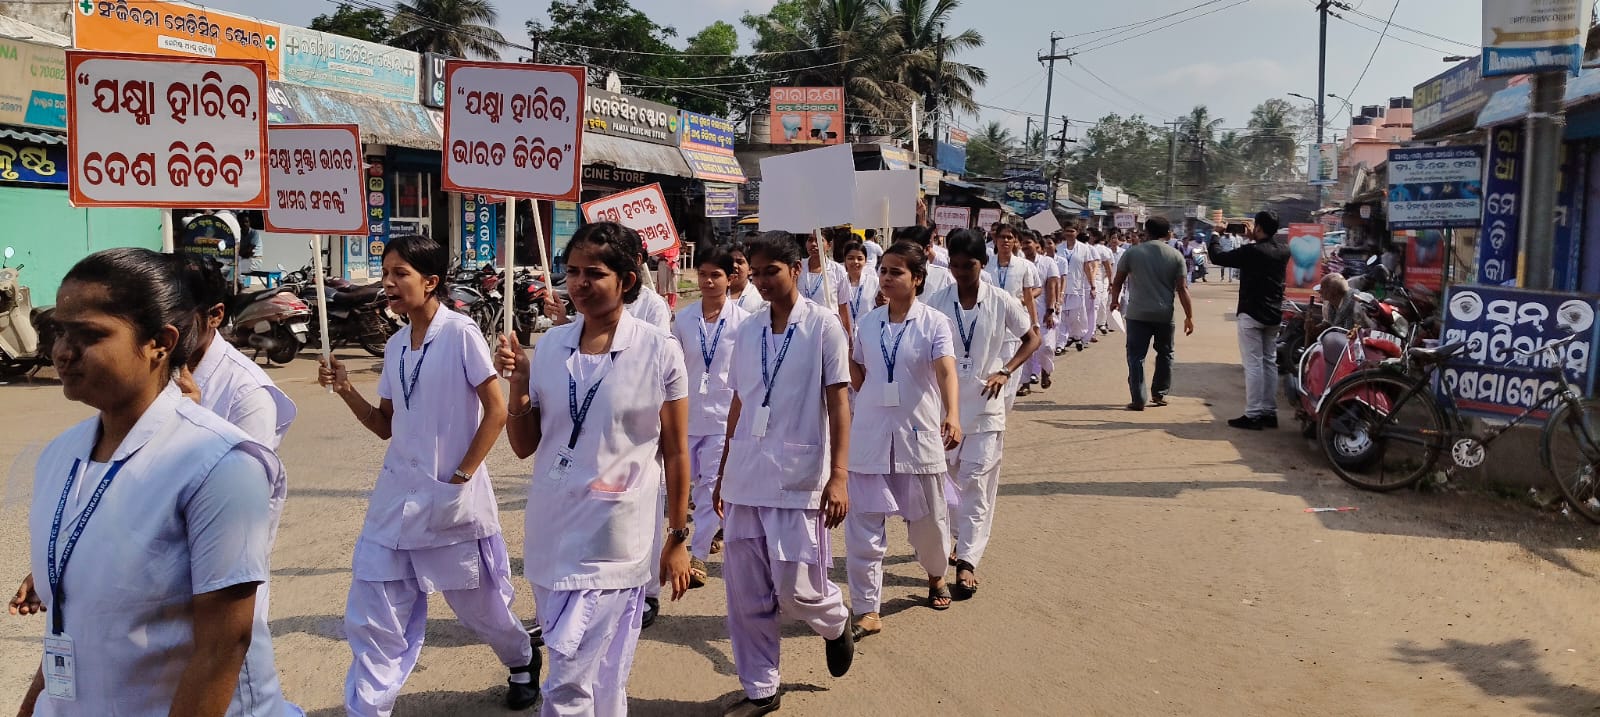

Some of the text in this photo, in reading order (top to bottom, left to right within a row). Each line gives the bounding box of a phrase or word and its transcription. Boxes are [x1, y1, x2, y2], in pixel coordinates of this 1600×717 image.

[166, 71, 257, 124] ହାରିବ,
[511, 86, 570, 123] ହାରିବ,
[83, 140, 255, 188] ଦେଶ ଜିତିବ”
[452, 135, 571, 171] ଭାରତ ଜିତିବ”
[613, 170, 645, 184] STORE
[277, 189, 307, 212] ଆମର
[63, 542, 74, 560] ANM
[79, 478, 110, 528] KENDRAPARA
